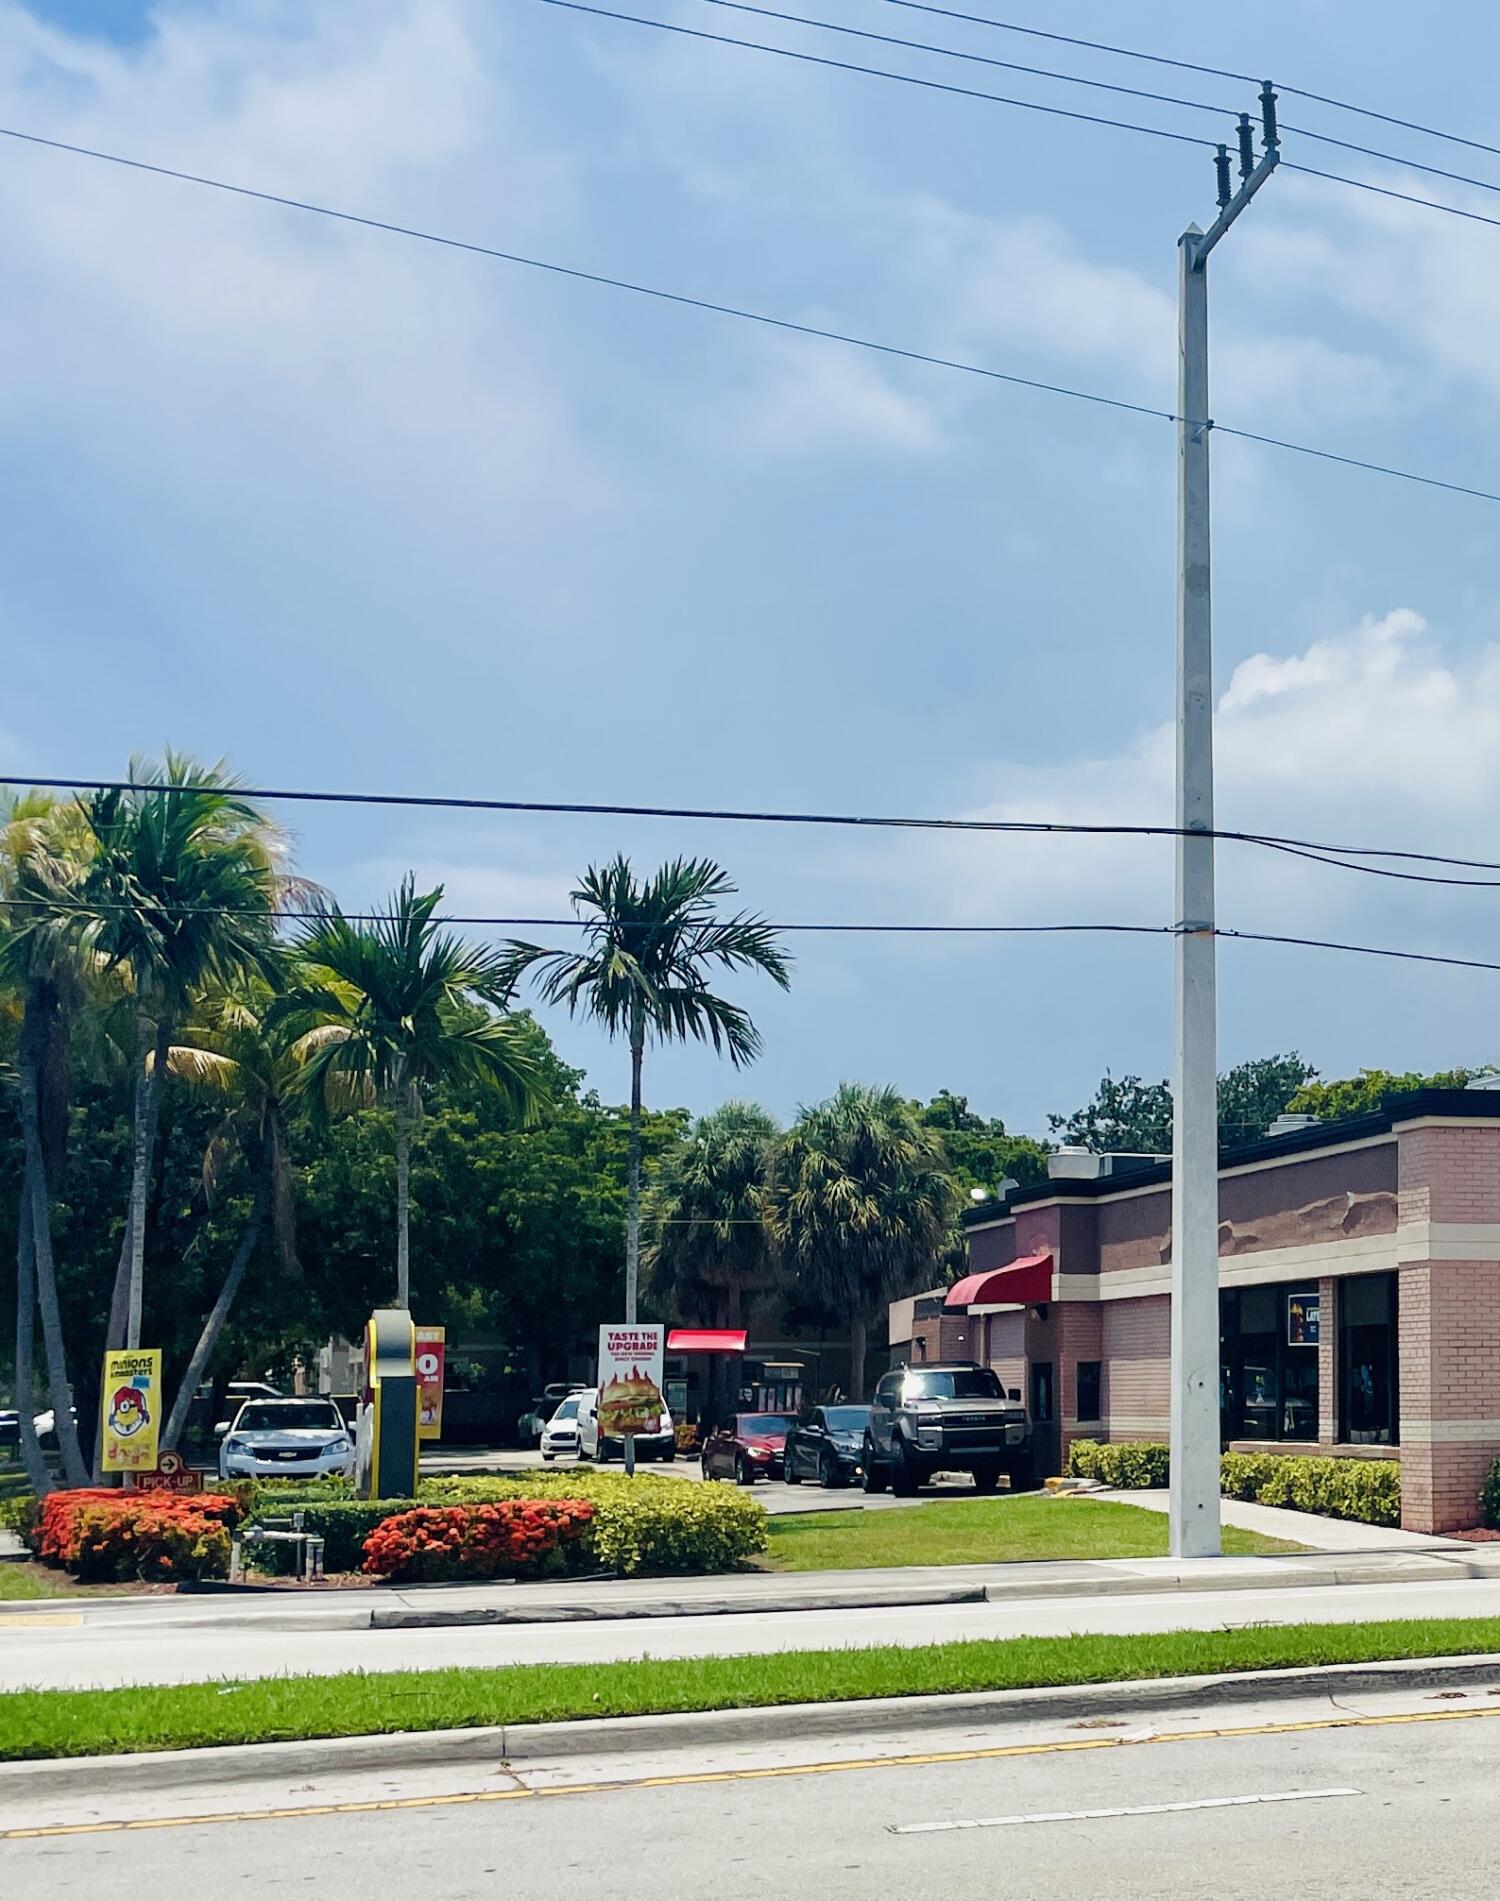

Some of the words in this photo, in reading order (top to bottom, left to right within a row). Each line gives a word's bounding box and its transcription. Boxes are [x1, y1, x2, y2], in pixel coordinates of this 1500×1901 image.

[608, 1332, 639, 1341] TASTE
[641, 1332, 658, 1341] THE
[608, 1342, 658, 1351] UPGRADE
[143, 1476, 194, 1489] PICK-UP
